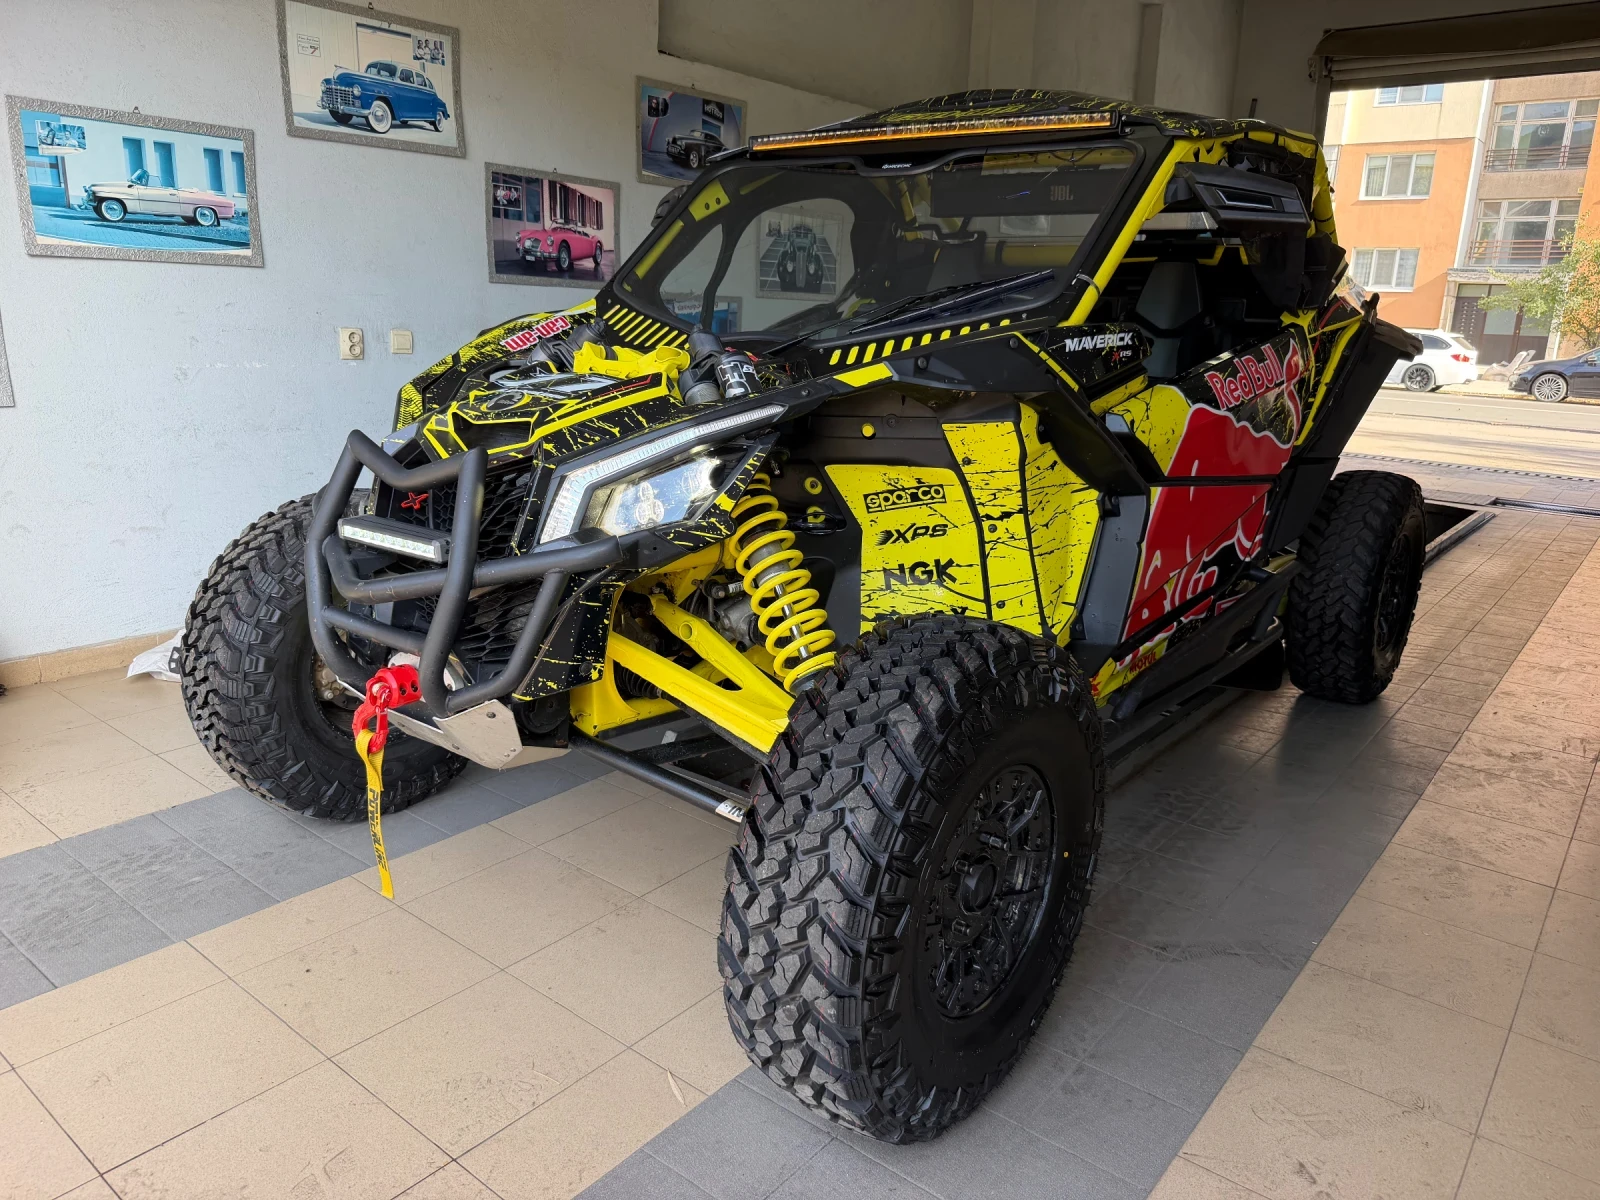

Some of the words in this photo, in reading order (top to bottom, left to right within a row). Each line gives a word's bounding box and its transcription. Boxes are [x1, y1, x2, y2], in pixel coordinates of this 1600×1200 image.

[1050, 185, 1074, 201] JBL
[503, 316, 571, 351] can-am
[1064, 332, 1133, 352] MAVERICK
[865, 485, 945, 512] sparco
[890, 523, 949, 545] XPS
[883, 558, 957, 592] NGK
